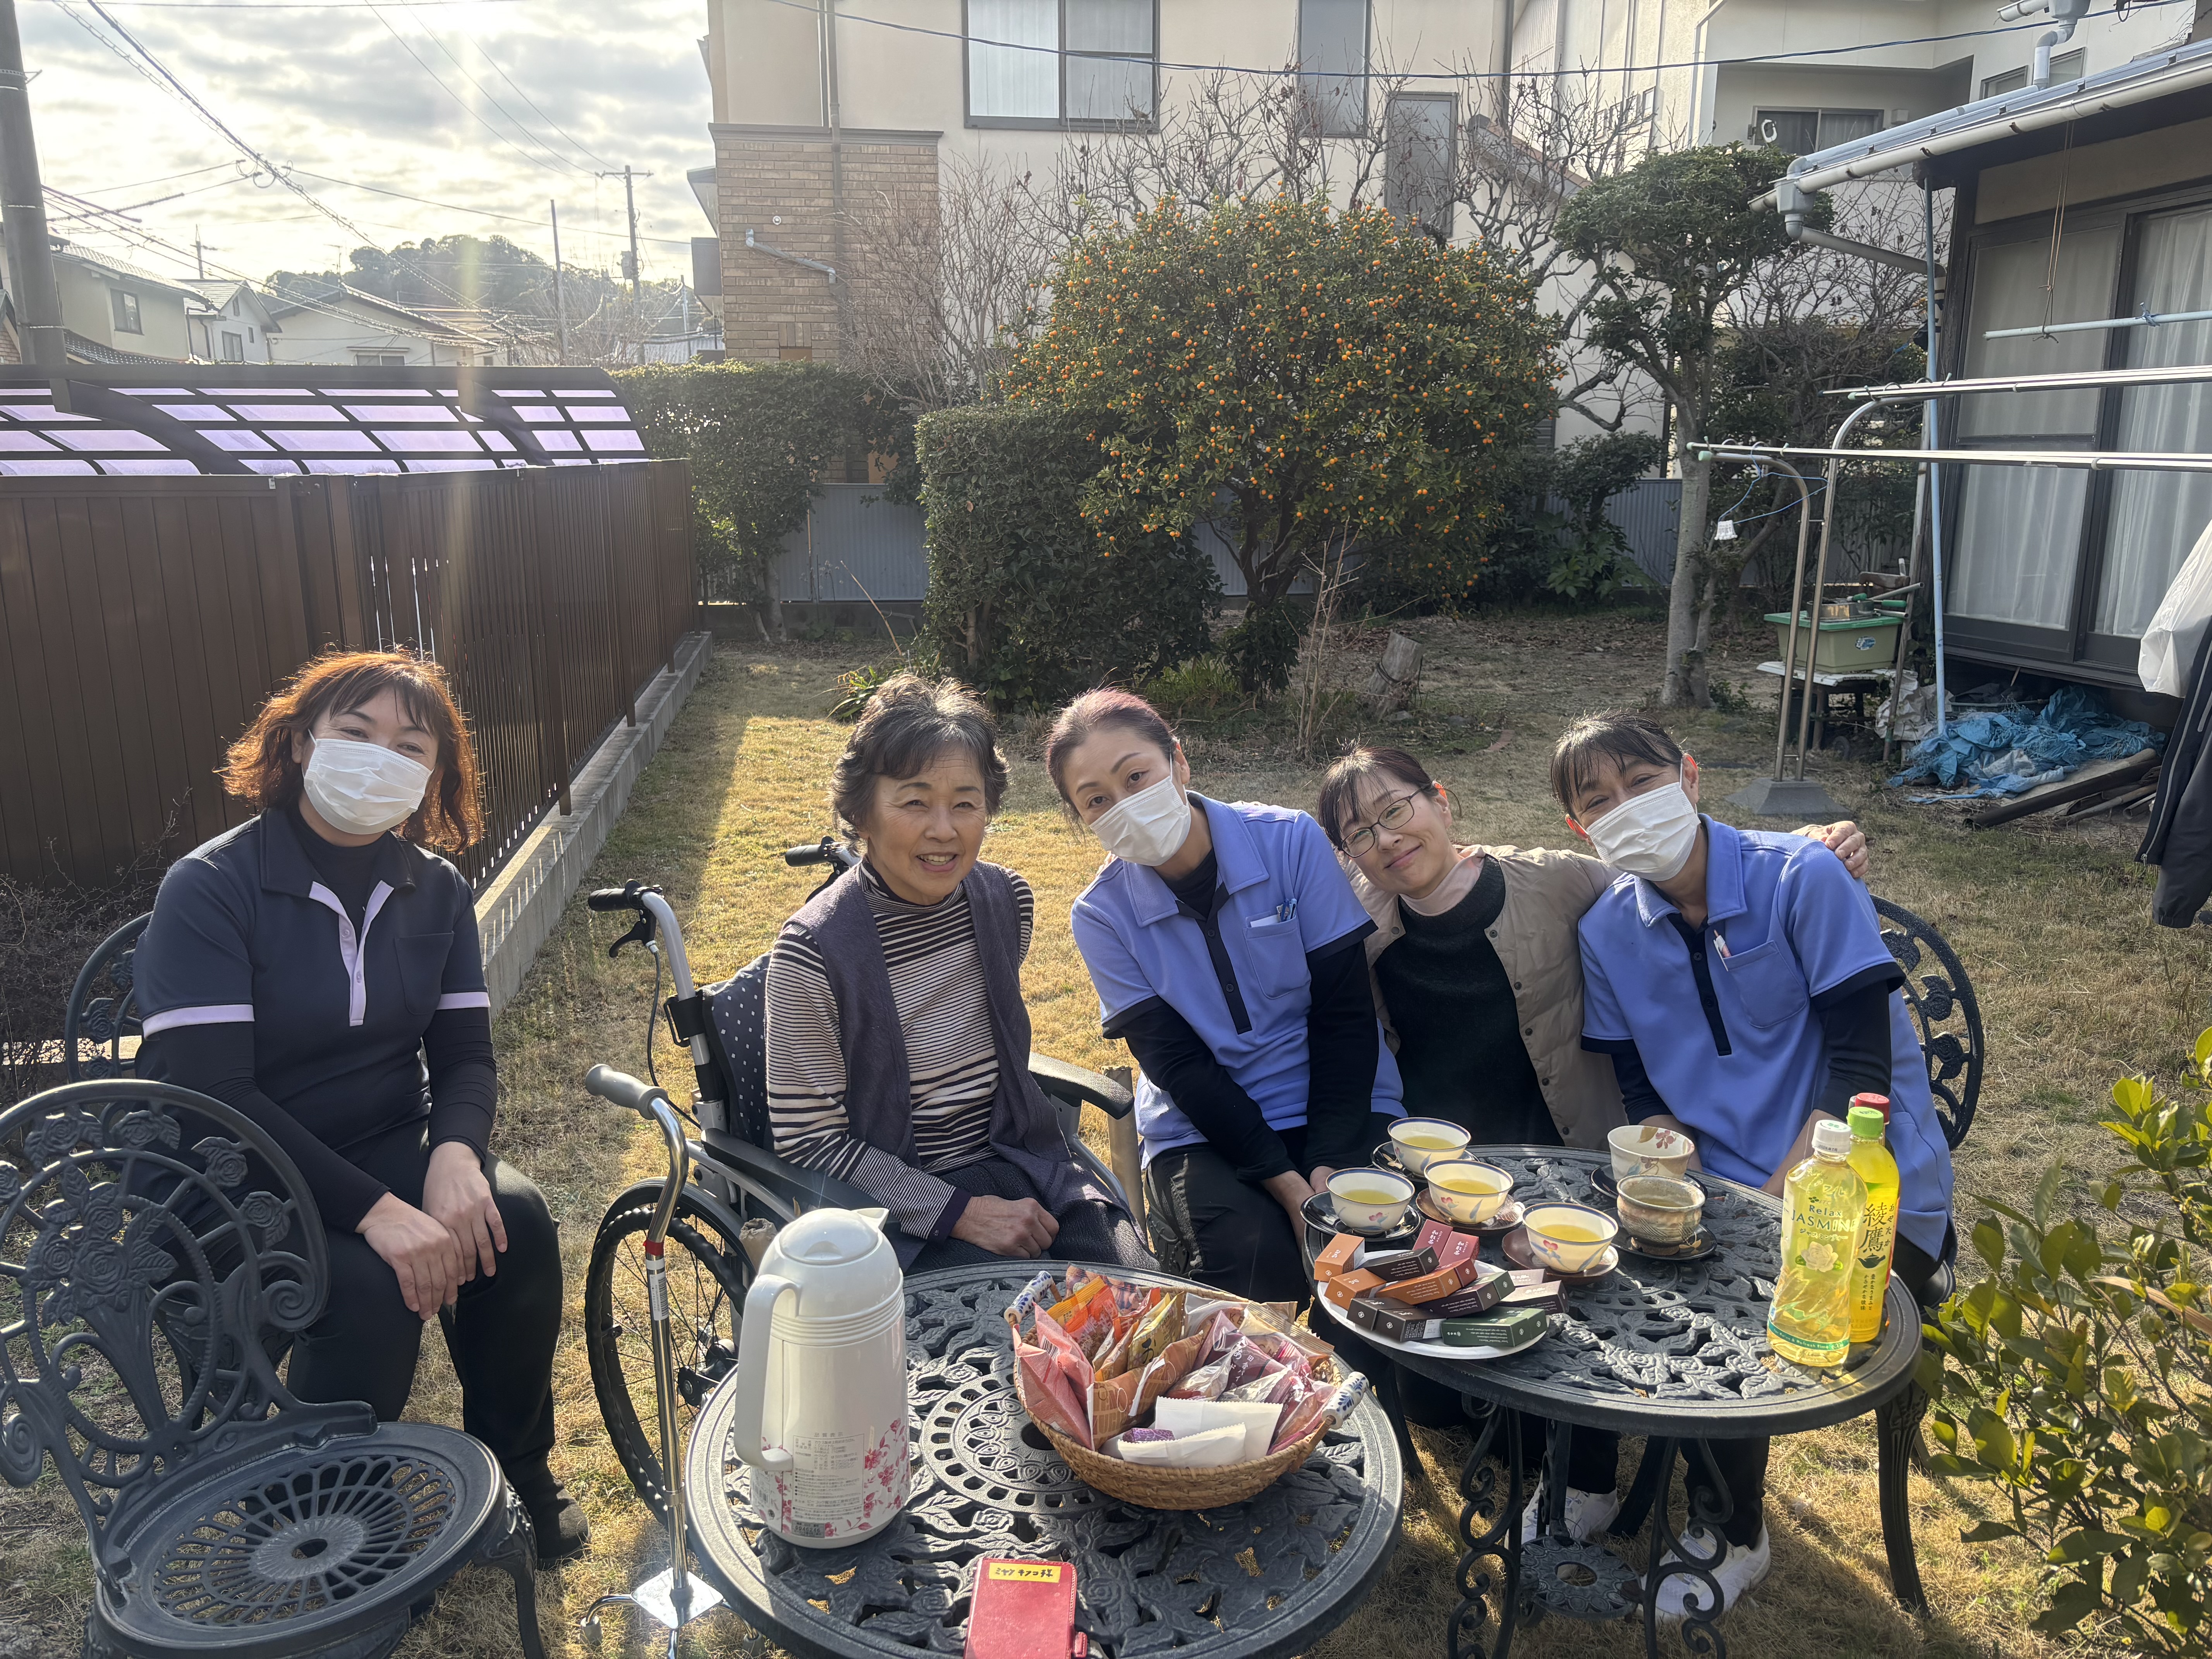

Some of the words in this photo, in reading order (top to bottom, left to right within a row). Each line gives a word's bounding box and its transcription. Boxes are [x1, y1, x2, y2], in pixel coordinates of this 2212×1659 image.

[1791, 1209, 1860, 1231] JASMINE
[1809, 1204, 1842, 1216] Relax
[1800, 1228, 1848, 1241] ジャスミンティー
[1858, 1202, 1887, 1253] 綾鷹
[1884, 1204, 1894, 1247] あやたか
[1235, 1355, 1254, 1382] 田舎パイ
